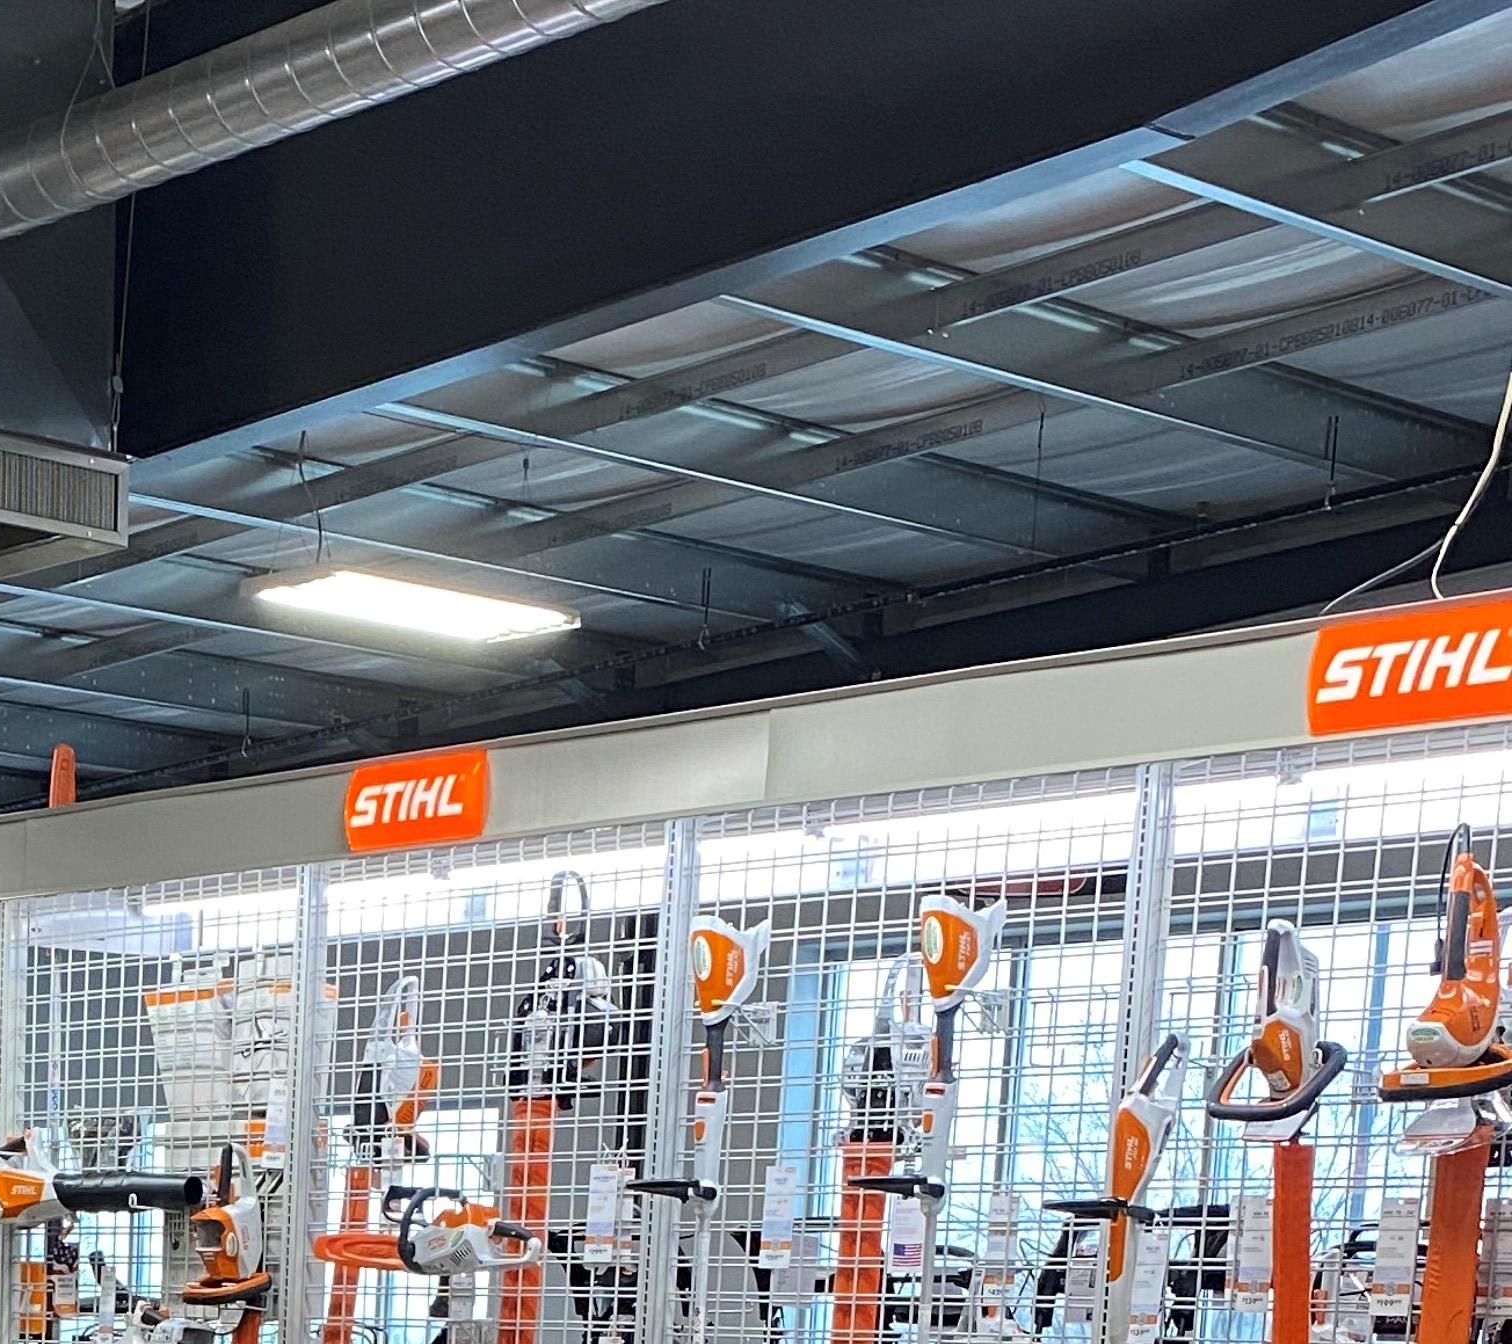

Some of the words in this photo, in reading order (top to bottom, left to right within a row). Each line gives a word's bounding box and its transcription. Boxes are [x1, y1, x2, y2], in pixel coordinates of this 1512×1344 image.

[1316, 628, 1512, 704] STIHL
[350, 774, 464, 828] STIHL
[10, 1185, 39, 1195] STIHL
